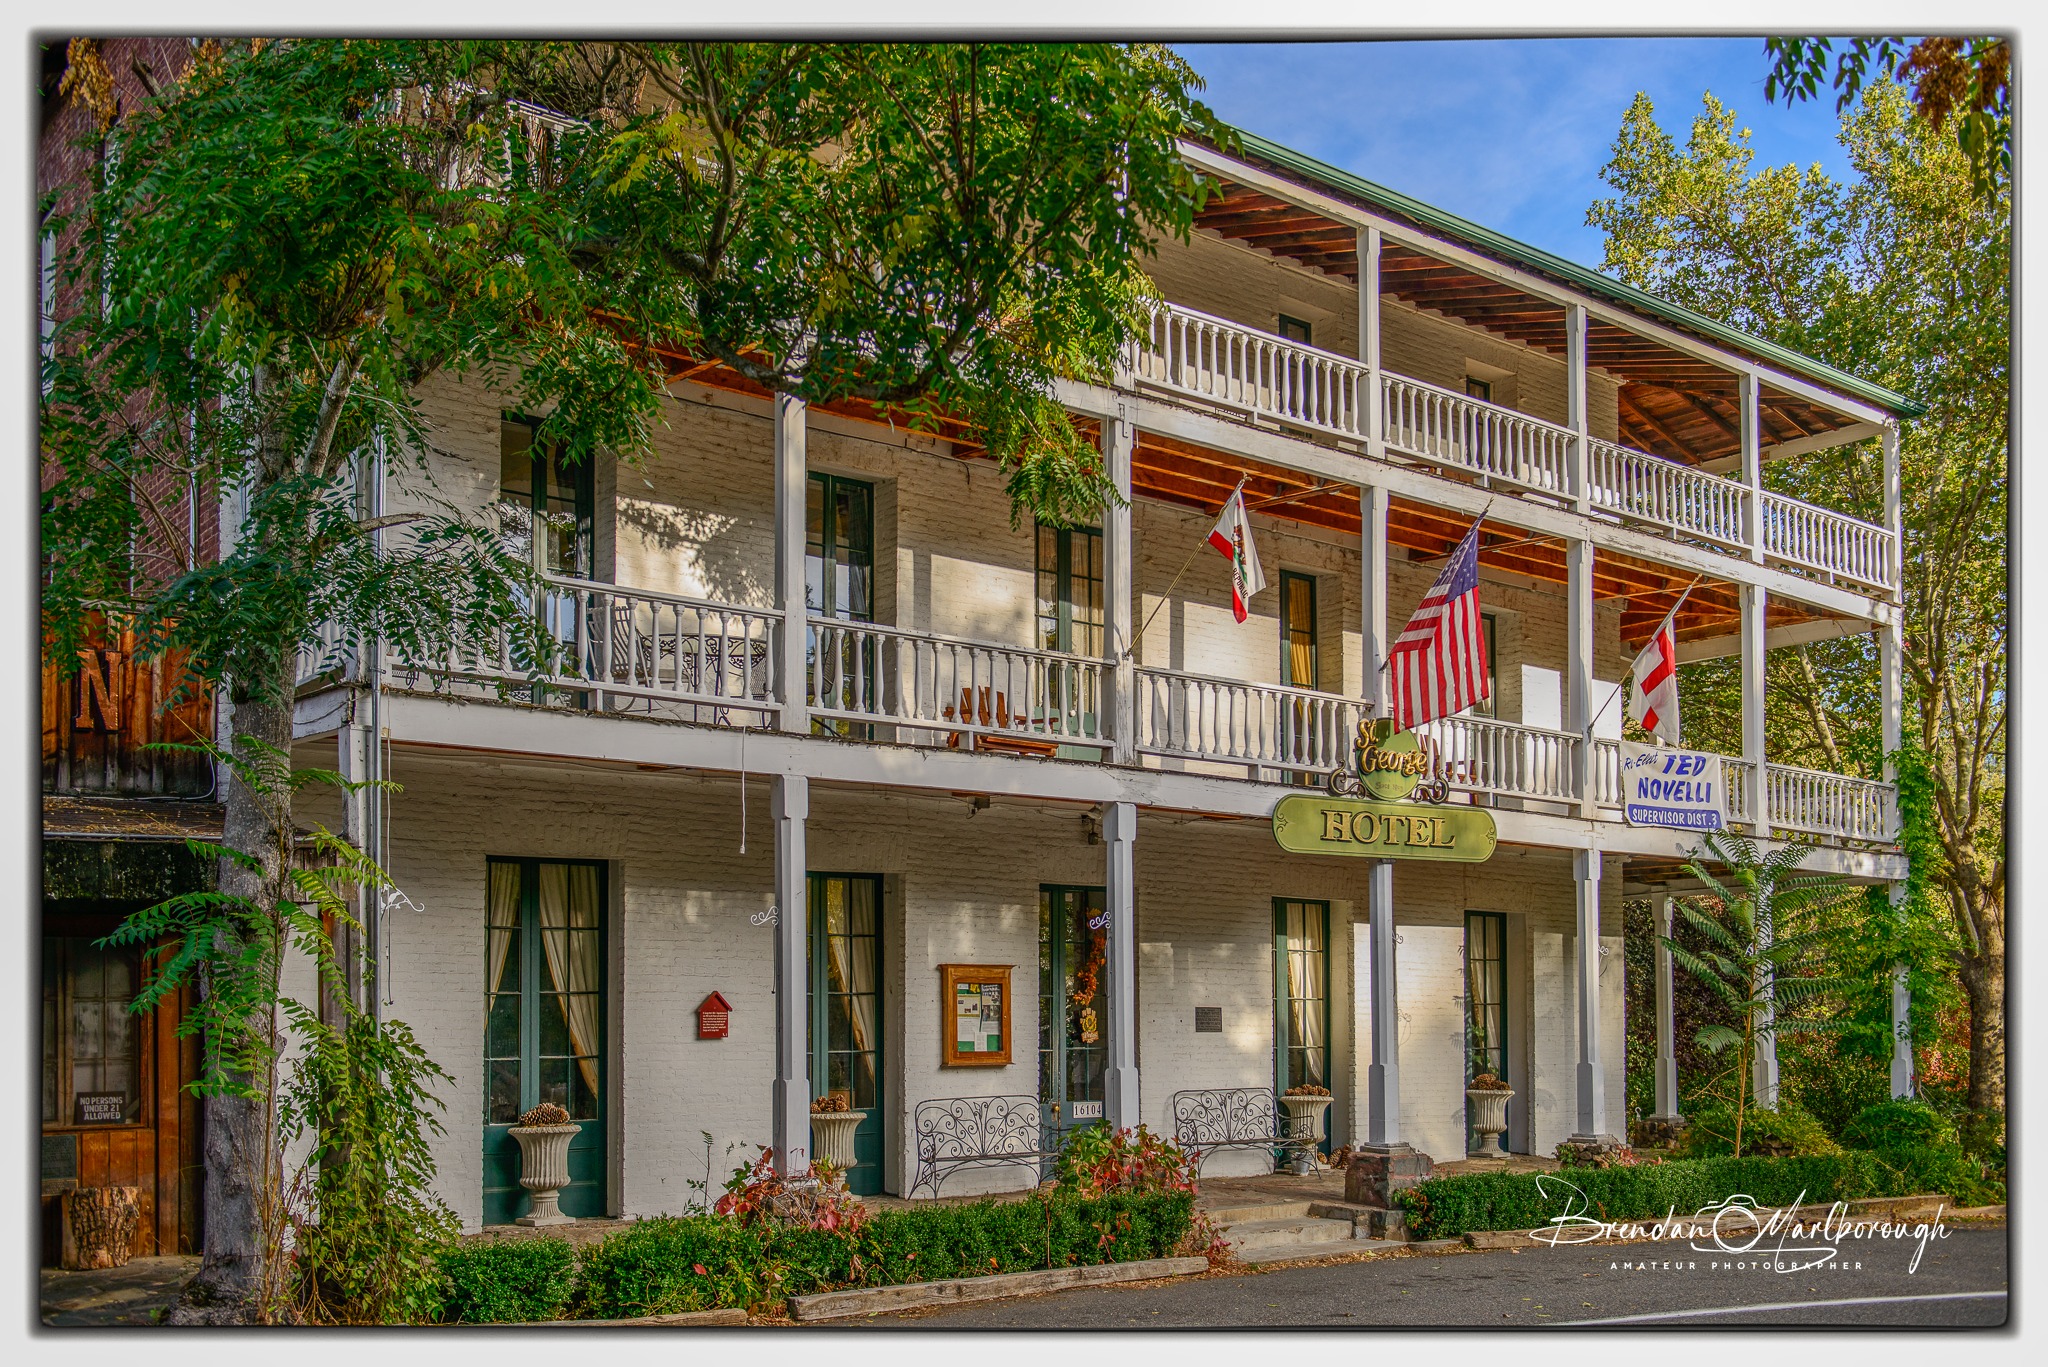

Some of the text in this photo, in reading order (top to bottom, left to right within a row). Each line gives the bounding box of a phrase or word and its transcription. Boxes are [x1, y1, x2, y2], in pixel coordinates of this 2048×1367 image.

[1233, 568, 1249, 599] REPUBLIC
[1356, 717, 1379, 748] St.
[1359, 746, 1427, 777] George
[1662, 754, 1707, 777] TED
[1637, 777, 1712, 804] NOVELLI
[1632, 808, 1685, 824] SUPERVISOR
[1320, 809, 1456, 849] HOTEL
[80, 1096, 123, 1105] NO PERSONS
[84, 1104, 120, 1112] UNDER 21
[1074, 1104, 1102, 1116] 16104
[84, 1112, 121, 1120] ALLOWED
